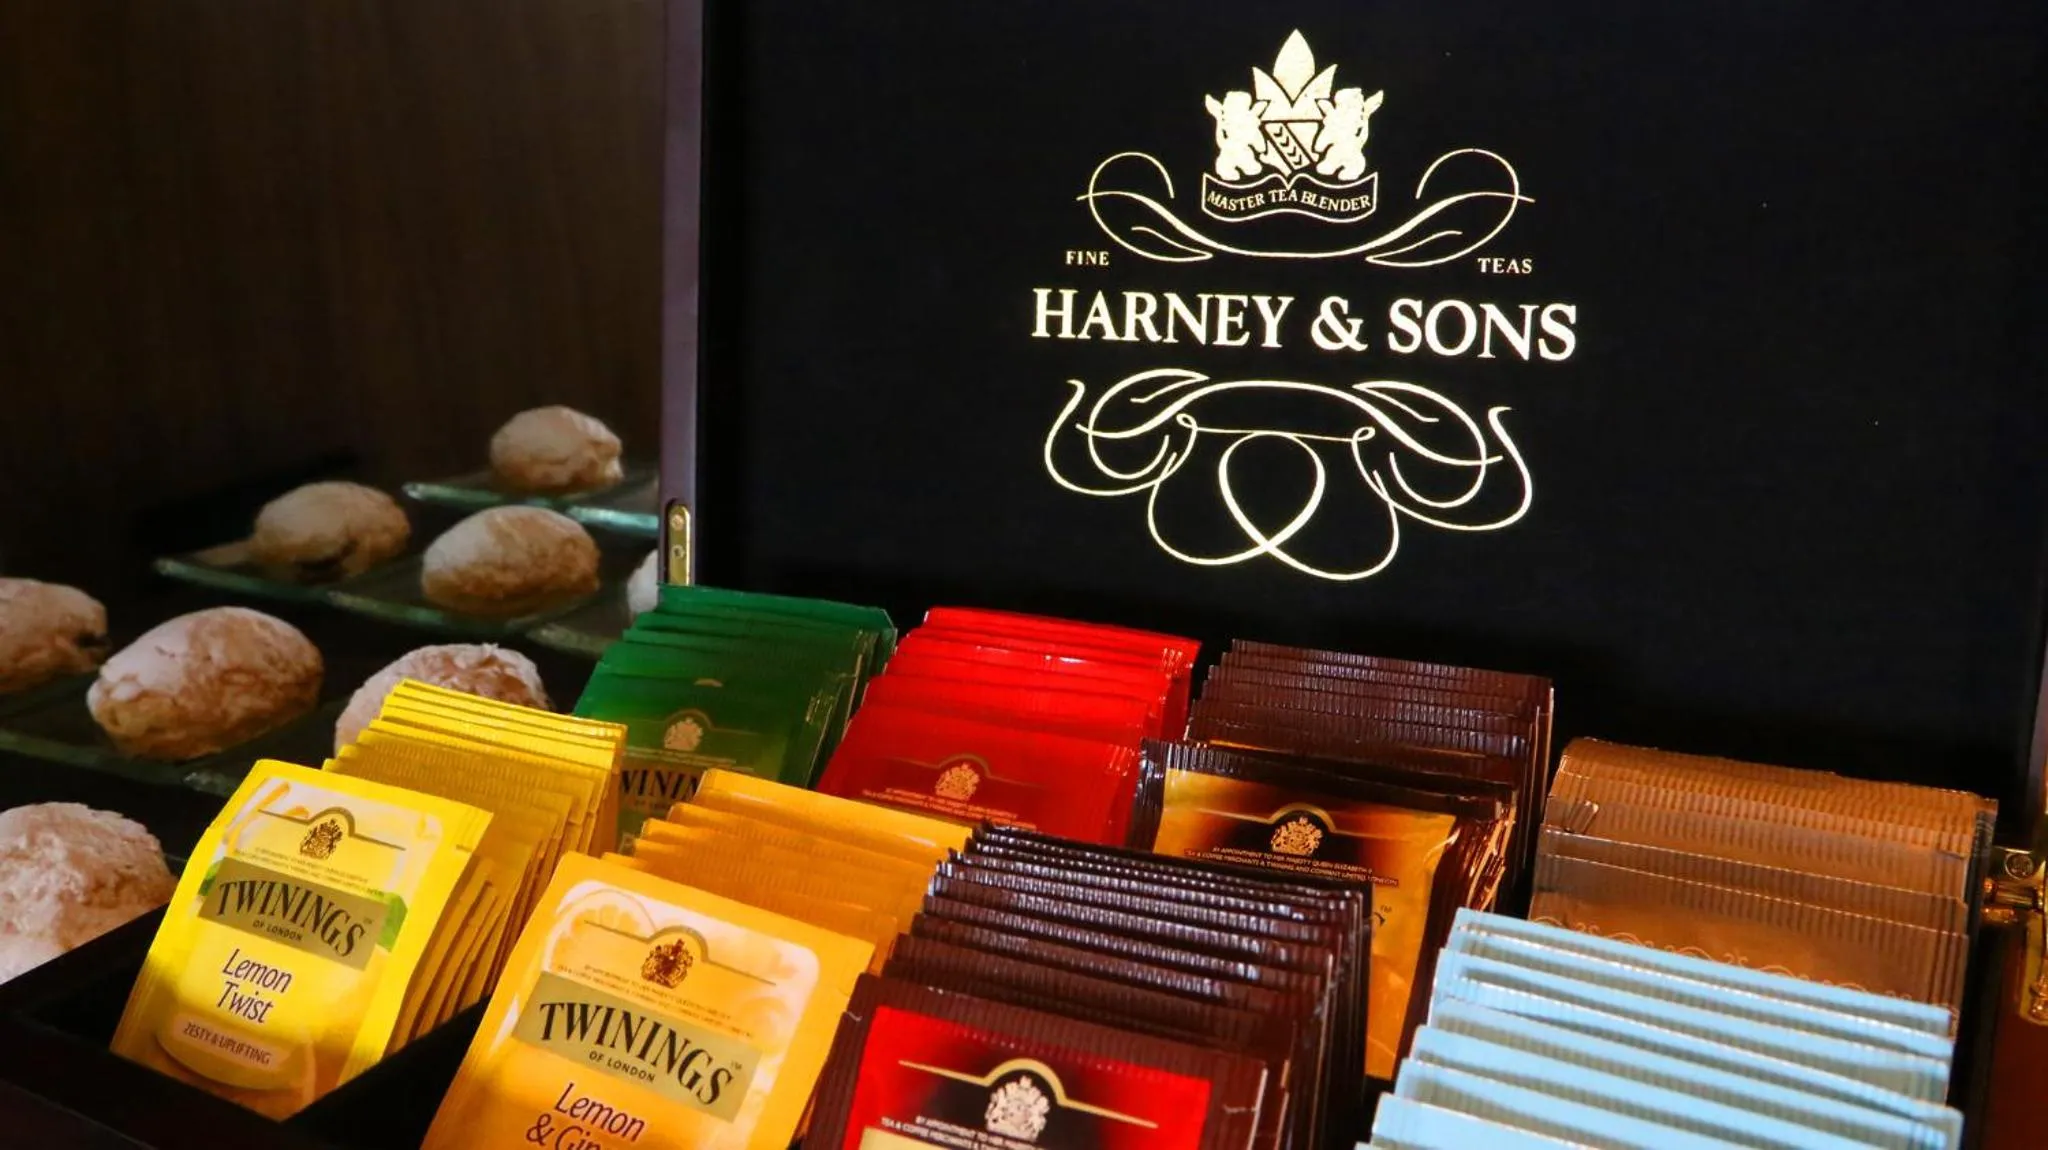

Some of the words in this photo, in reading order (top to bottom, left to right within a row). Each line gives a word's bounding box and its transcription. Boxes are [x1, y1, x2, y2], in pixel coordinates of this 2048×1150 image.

[1207, 190, 1265, 211] MASTER
[1268, 189, 1298, 203] TEA
[1300, 190, 1372, 212] BLENDER
[1065, 250, 1110, 267] FINE
[1478, 257, 1533, 275] TEAS
[1031, 288, 1294, 349] HARNEY
[1311, 295, 1368, 352] &
[1387, 298, 1577, 361] SONS
[217, 878, 365, 958] TWININGS
[252, 920, 265, 929] OF
[266, 923, 302, 942] LONDON
[222, 948, 292, 993] Lemon
[217, 981, 273, 1023] Twist
[183, 1022, 211, 1043] ZESTY
[218, 1035, 272, 1064] UPLIFTING
[539, 1002, 733, 1105] TWININGS
[589, 1050, 604, 1063] OF
[607, 1057, 655, 1083] LONDON
[526, 1113, 555, 1146] &
[554, 1082, 645, 1142] Lemon
